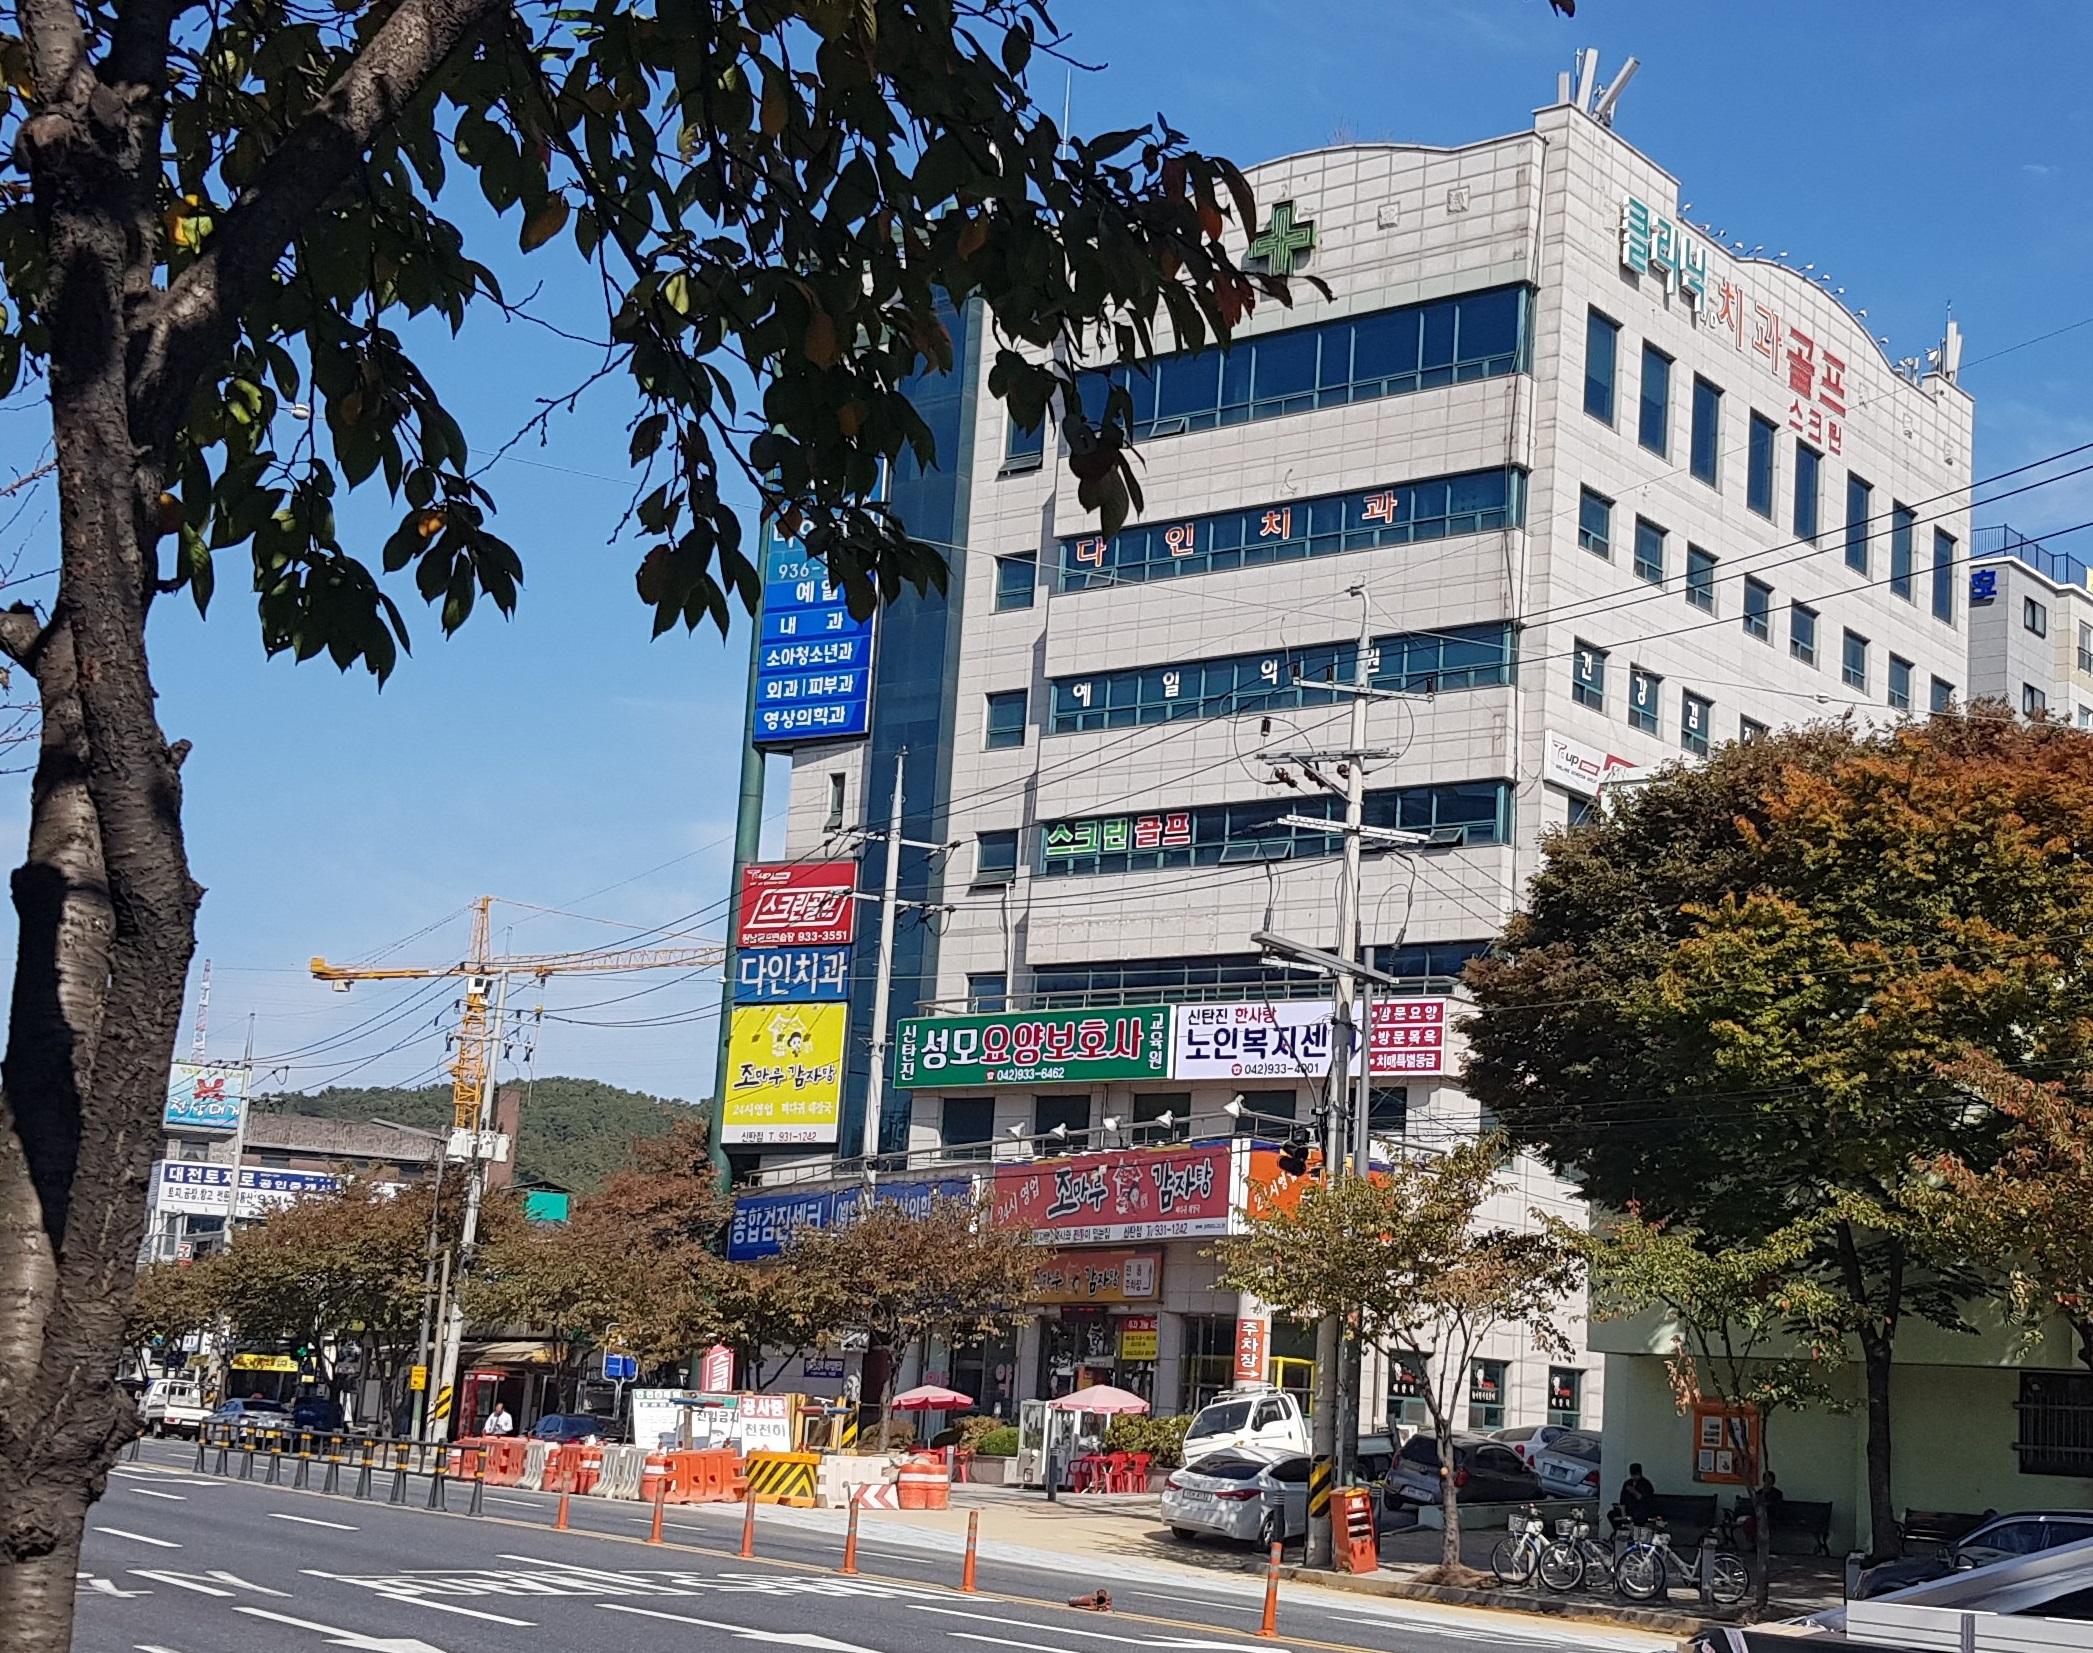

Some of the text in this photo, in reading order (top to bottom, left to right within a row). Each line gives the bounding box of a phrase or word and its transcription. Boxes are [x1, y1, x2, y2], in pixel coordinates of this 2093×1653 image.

[1622, 195, 1708, 315] 클리닉
[1720, 278, 1783, 377] 치과
[1787, 325, 1846, 419] 골프
[1789, 398, 1843, 456] 스크린
[765, 641, 853, 668] 소아청소년과
[765, 674, 854, 700] 외과 피부과
[763, 705, 846, 731] 영상의학과
[1047, 811, 1192, 854] 스크린 골프
[797, 930, 848, 942] 933-3551
[741, 951, 847, 996] 다인치과
[1188, 1006, 1277, 1026] 신탄진 한사랑
[1379, 1005, 1438, 1022] 방문요양
[1149, 1013, 1165, 1070] 교육원
[1377, 1028, 1437, 1046] 방문목욕
[900, 1024, 917, 1081] 신탄진
[733, 1063, 836, 1089] 조마루 감자탕
[997, 1067, 1065, 1081] 042)933-6462
[1046, 1157, 1214, 1219] 조마루 감자탕
[1239, 1321, 1260, 1368] 주차장
[743, 1397, 785, 1417] 공사중
[745, 1422, 786, 1437] 천천히
